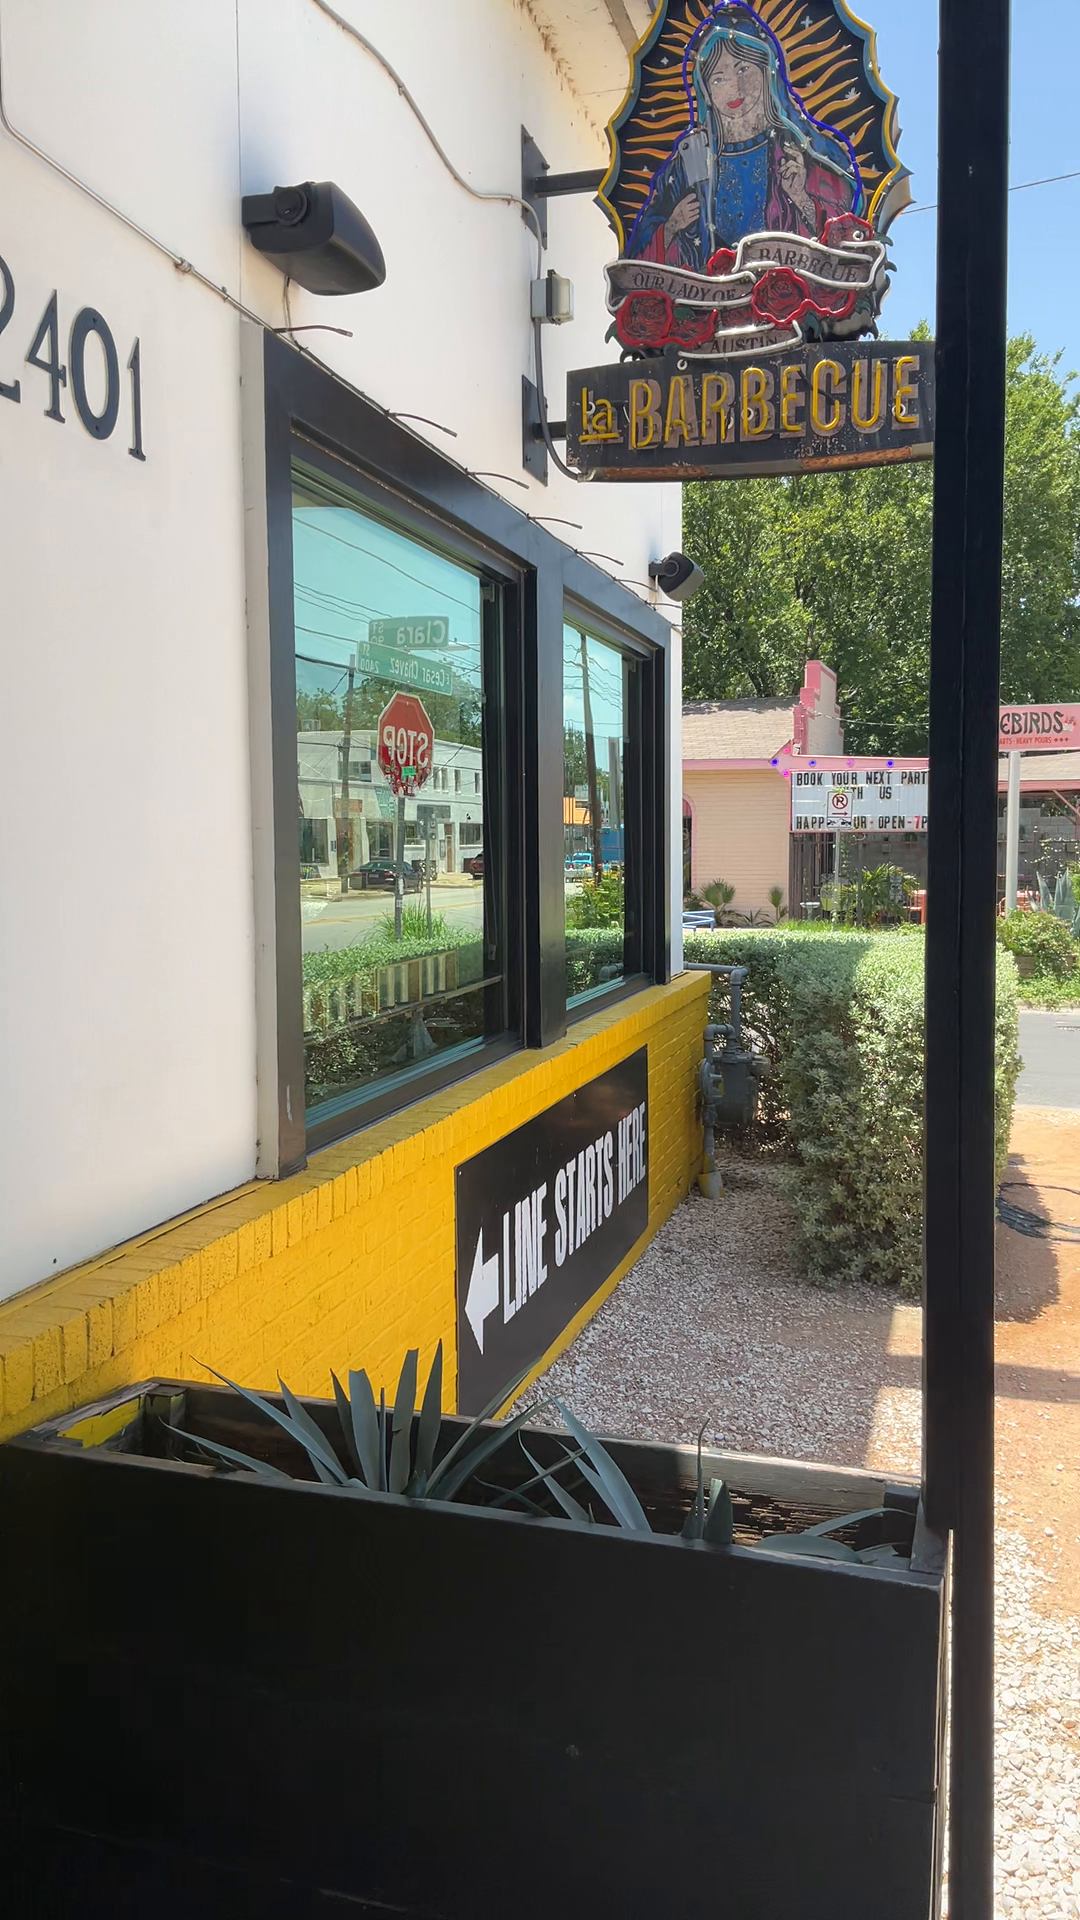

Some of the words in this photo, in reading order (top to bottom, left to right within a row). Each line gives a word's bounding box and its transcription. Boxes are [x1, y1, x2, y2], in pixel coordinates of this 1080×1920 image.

[759, 248, 859, 283] BARBECUE
[633, 272, 664, 290] OUR
[669, 281, 711, 301] LADY
[713, 289, 737, 302] OF
[710, 336, 778, 353] AUSTIN
[628, 355, 920, 450] BARBECUE
[1000, 711, 1064, 735] EBIRDS
[796, 772, 823, 786] BOOK
[831, 772, 858, 786] YOUR
[865, 771, 892, 785] NEXT
[900, 771, 927, 785] PART
[879, 787, 892, 799] US
[796, 816, 825, 829] HAPP
[853, 816, 867, 829] UR
[503, 1181, 548, 1325] LINE
[554, 1130, 614, 1268] STARTS
[618, 1101, 646, 1206] HERE
